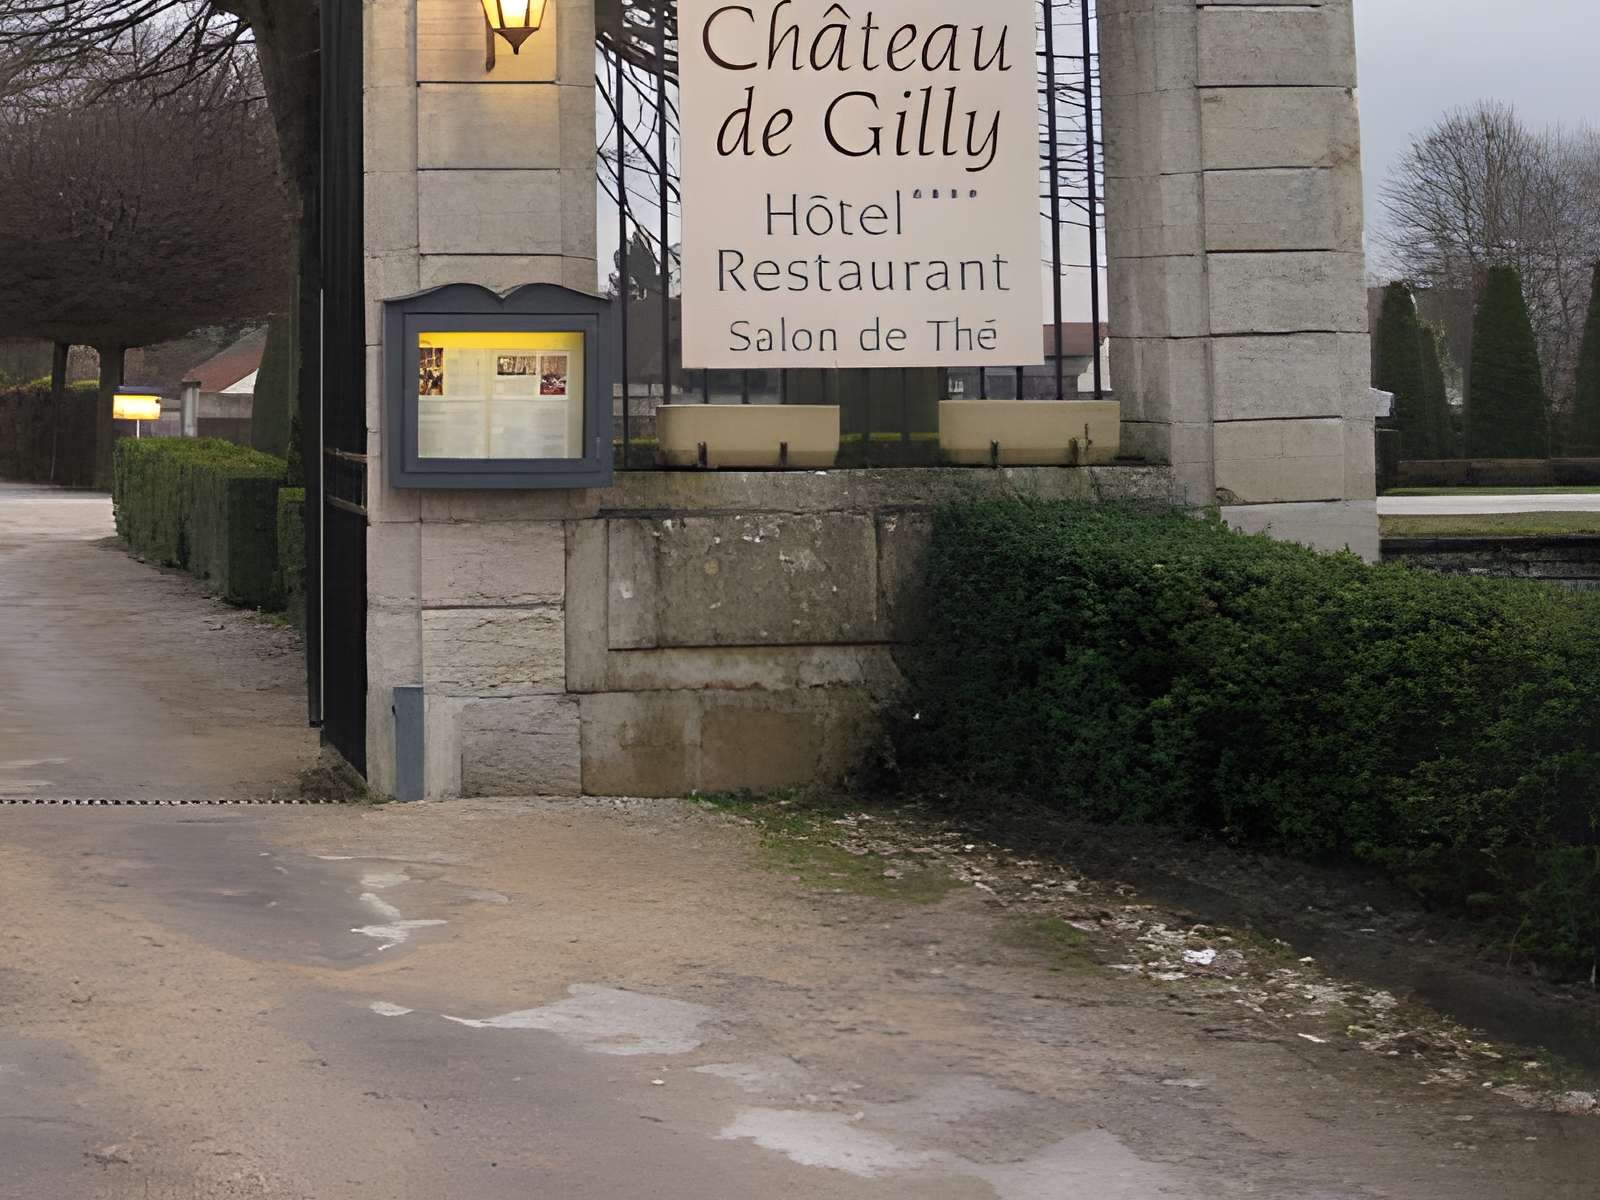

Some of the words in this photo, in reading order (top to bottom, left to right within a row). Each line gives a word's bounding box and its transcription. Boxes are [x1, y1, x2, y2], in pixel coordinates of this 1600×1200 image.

[716, 85, 794, 158] de
[823, 85, 1002, 173] Gilly
[766, 189, 903, 237] Hôtel
[717, 248, 1011, 292] Restaurant
[729, 316, 838, 353] Salon
[859, 316, 908, 353] de
[925, 316, 998, 353] Thé
